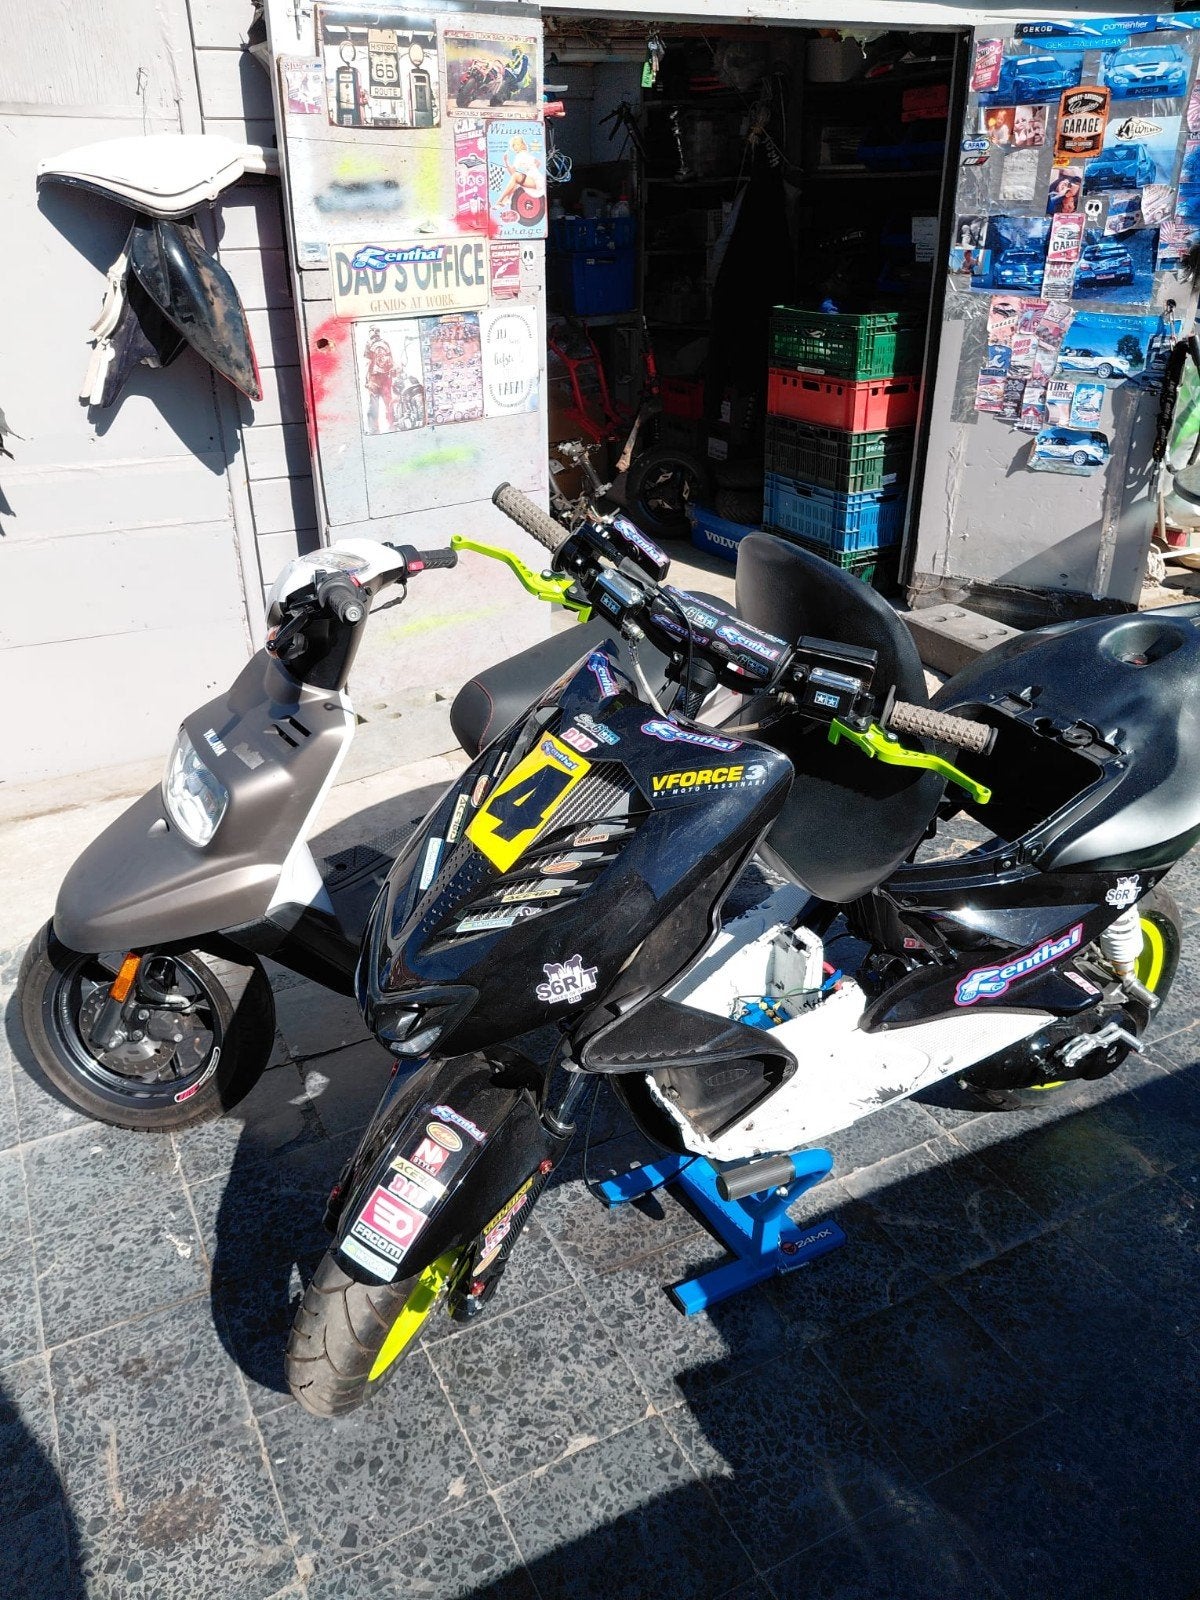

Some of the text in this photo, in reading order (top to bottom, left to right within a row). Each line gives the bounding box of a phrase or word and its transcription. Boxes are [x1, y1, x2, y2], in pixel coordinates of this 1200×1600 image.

[375, 63, 394, 79] 66
[374, 88, 398, 96] ROUTE
[1063, 118, 1100, 134] GARAGE
[352, 246, 444, 269] Renthal
[370, 299, 407, 313] GENIUS
[410, 297, 422, 310] AT
[1049, 381, 1069, 391] TIRE
[614, 520, 667, 565] Renthal
[716, 626, 778, 659] Renthal
[589, 652, 617, 697] Renthal
[203, 728, 228, 757] YAMAHA
[643, 721, 741, 750] Renthal
[542, 740, 577, 769] Renthal
[652, 764, 767, 791] VFORCE 3
[653, 779, 766, 798] BY MOTO TASSINARI
[486, 764, 574, 843] 4
[959, 927, 1081, 1001] Renthal
[431, 1105, 486, 1142] Renthal
[412, 1156, 437, 1175] STYLE
[354, 1223, 402, 1259] FACOM
